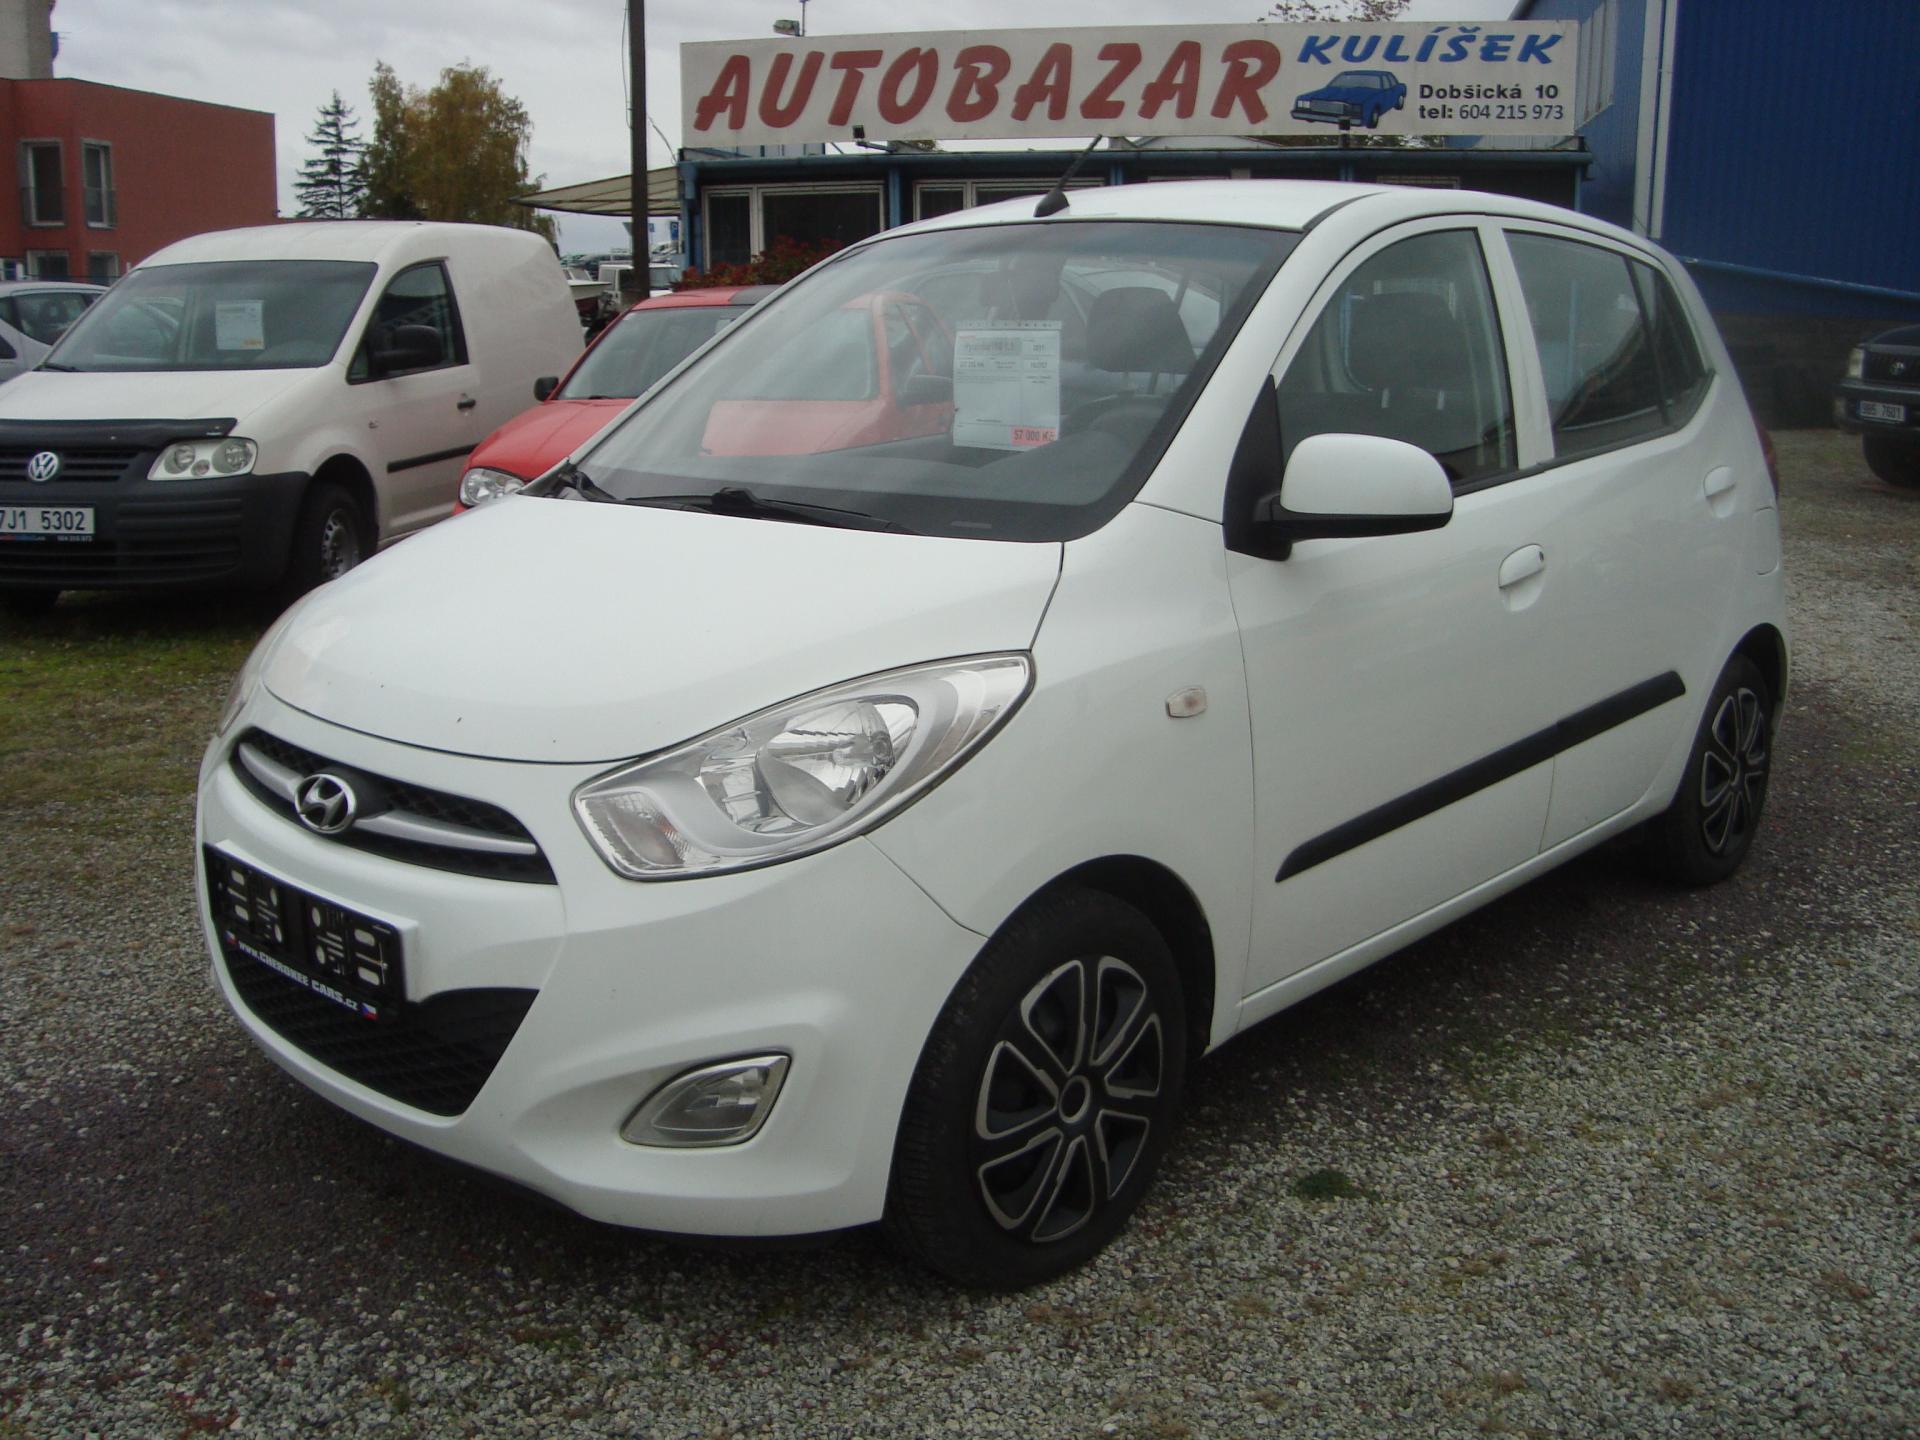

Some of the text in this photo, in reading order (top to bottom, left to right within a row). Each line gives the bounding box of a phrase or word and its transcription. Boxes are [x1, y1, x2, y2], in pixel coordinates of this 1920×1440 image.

[1296, 26, 1562, 65] KULÍŠEK
[693, 39, 1281, 131] AUTOBAZAR
[1419, 84, 1559, 99] Dobšická 10
[1418, 104, 1564, 119] tel: 604 215 973
[1014, 429, 1023, 440] 57
[41, 511, 85, 530] 5302
